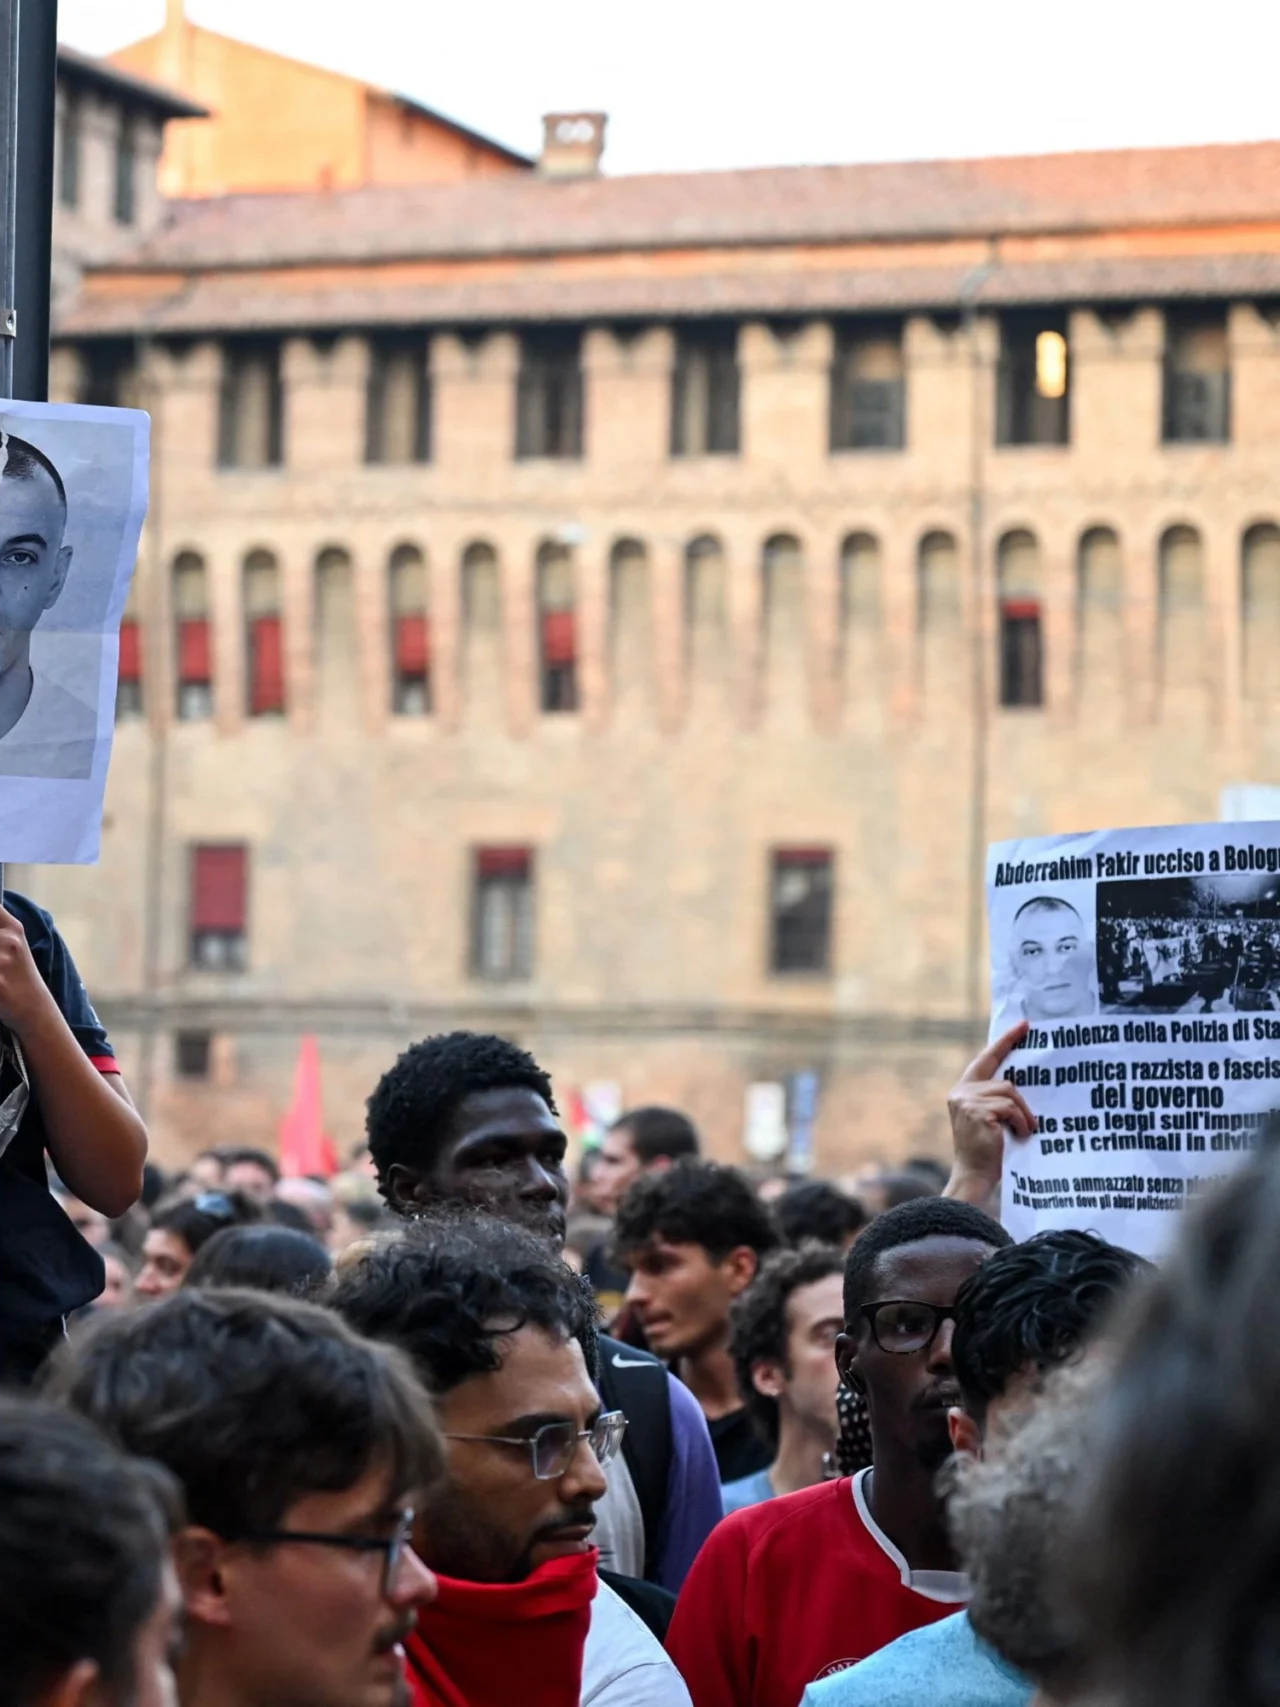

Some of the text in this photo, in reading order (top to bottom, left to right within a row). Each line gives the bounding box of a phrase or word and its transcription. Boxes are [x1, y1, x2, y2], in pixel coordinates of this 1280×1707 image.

[994, 844, 1280, 888] Abderrahim Fakir ucciso a Bolog
[1051, 1024, 1120, 1049] violenza
[1123, 1020, 1167, 1043] della
[1170, 1020, 1229, 1043] Polizia
[1233, 1018, 1250, 1041] di
[1003, 1065, 1051, 1087] dalla
[1055, 1060, 1128, 1087] politica
[1131, 1058, 1204, 1081] razzista
[1208, 1061, 1220, 1081] e
[1091, 1082, 1224, 1111] del governo
[1062, 1115, 1100, 1132] sue
[1104, 1111, 1156, 1132] leggi
[1040, 1137, 1074, 1156] per
[1079, 1134, 1086, 1152] i
[1090, 1132, 1181, 1153] criminali
[1186, 1132, 1206, 1152] in
[1027, 1176, 1070, 1194] hanno
[1073, 1175, 1145, 1193] ammazzato
[1147, 1177, 1184, 1194] senza
[1076, 1194, 1098, 1208] dove
[1100, 1193, 1111, 1210] gli
[1113, 1193, 1135, 1210] abusi
